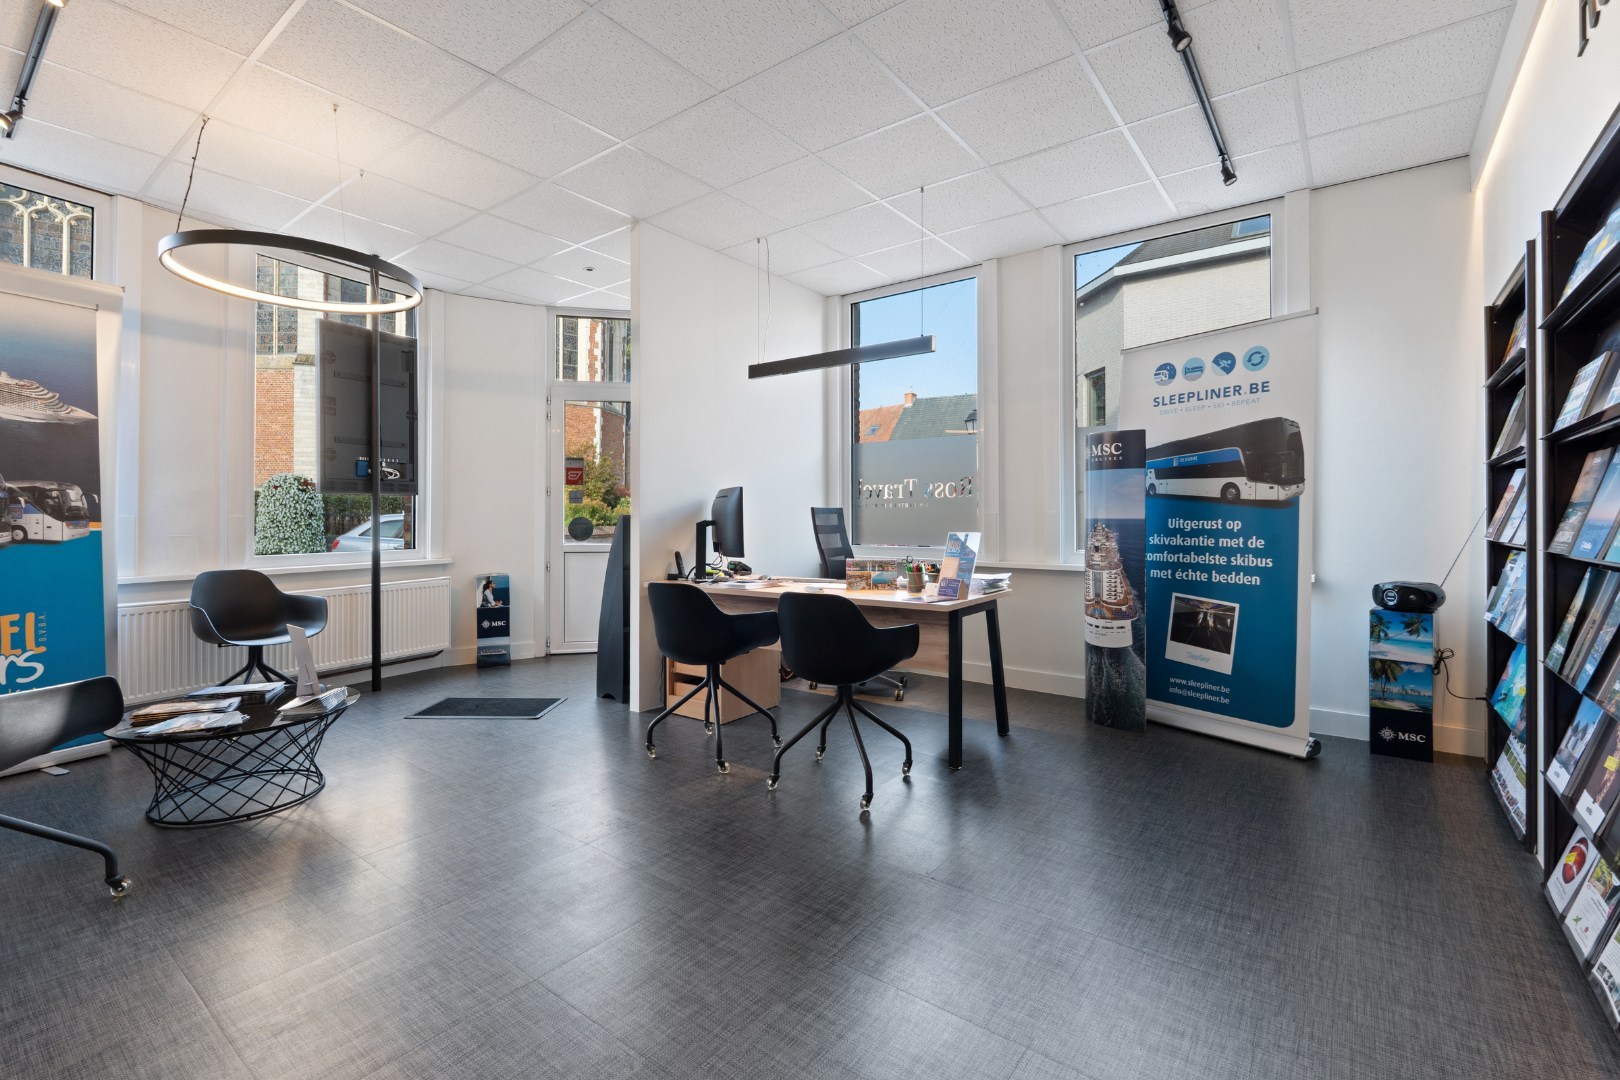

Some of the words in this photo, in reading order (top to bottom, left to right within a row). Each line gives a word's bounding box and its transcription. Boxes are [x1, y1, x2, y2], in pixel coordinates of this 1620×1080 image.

[1153, 381, 1270, 407] SLEEPLINER.BE
[1159, 408, 1179, 416] DRIVE
[1184, 404, 1206, 413] SLEEP
[1231, 398, 1261, 407] REPEAT
[1091, 442, 1122, 456] MSC
[1167, 518, 1223, 532] Uitgerust
[1226, 519, 1242, 532] op
[1149, 535, 1216, 548] skivakantie
[1219, 537, 1245, 548] met
[1247, 536, 1265, 549] de
[1230, 553, 1273, 568] skibus
[1150, 569, 1171, 579] met
[1175, 568, 1208, 581] échte
[1212, 570, 1260, 586] bedden
[1169, 676, 1231, 694] www.sleepliner.be
[1168, 686, 1230, 705] info@sleepliner.be
[1398, 731, 1426, 743] MSC
